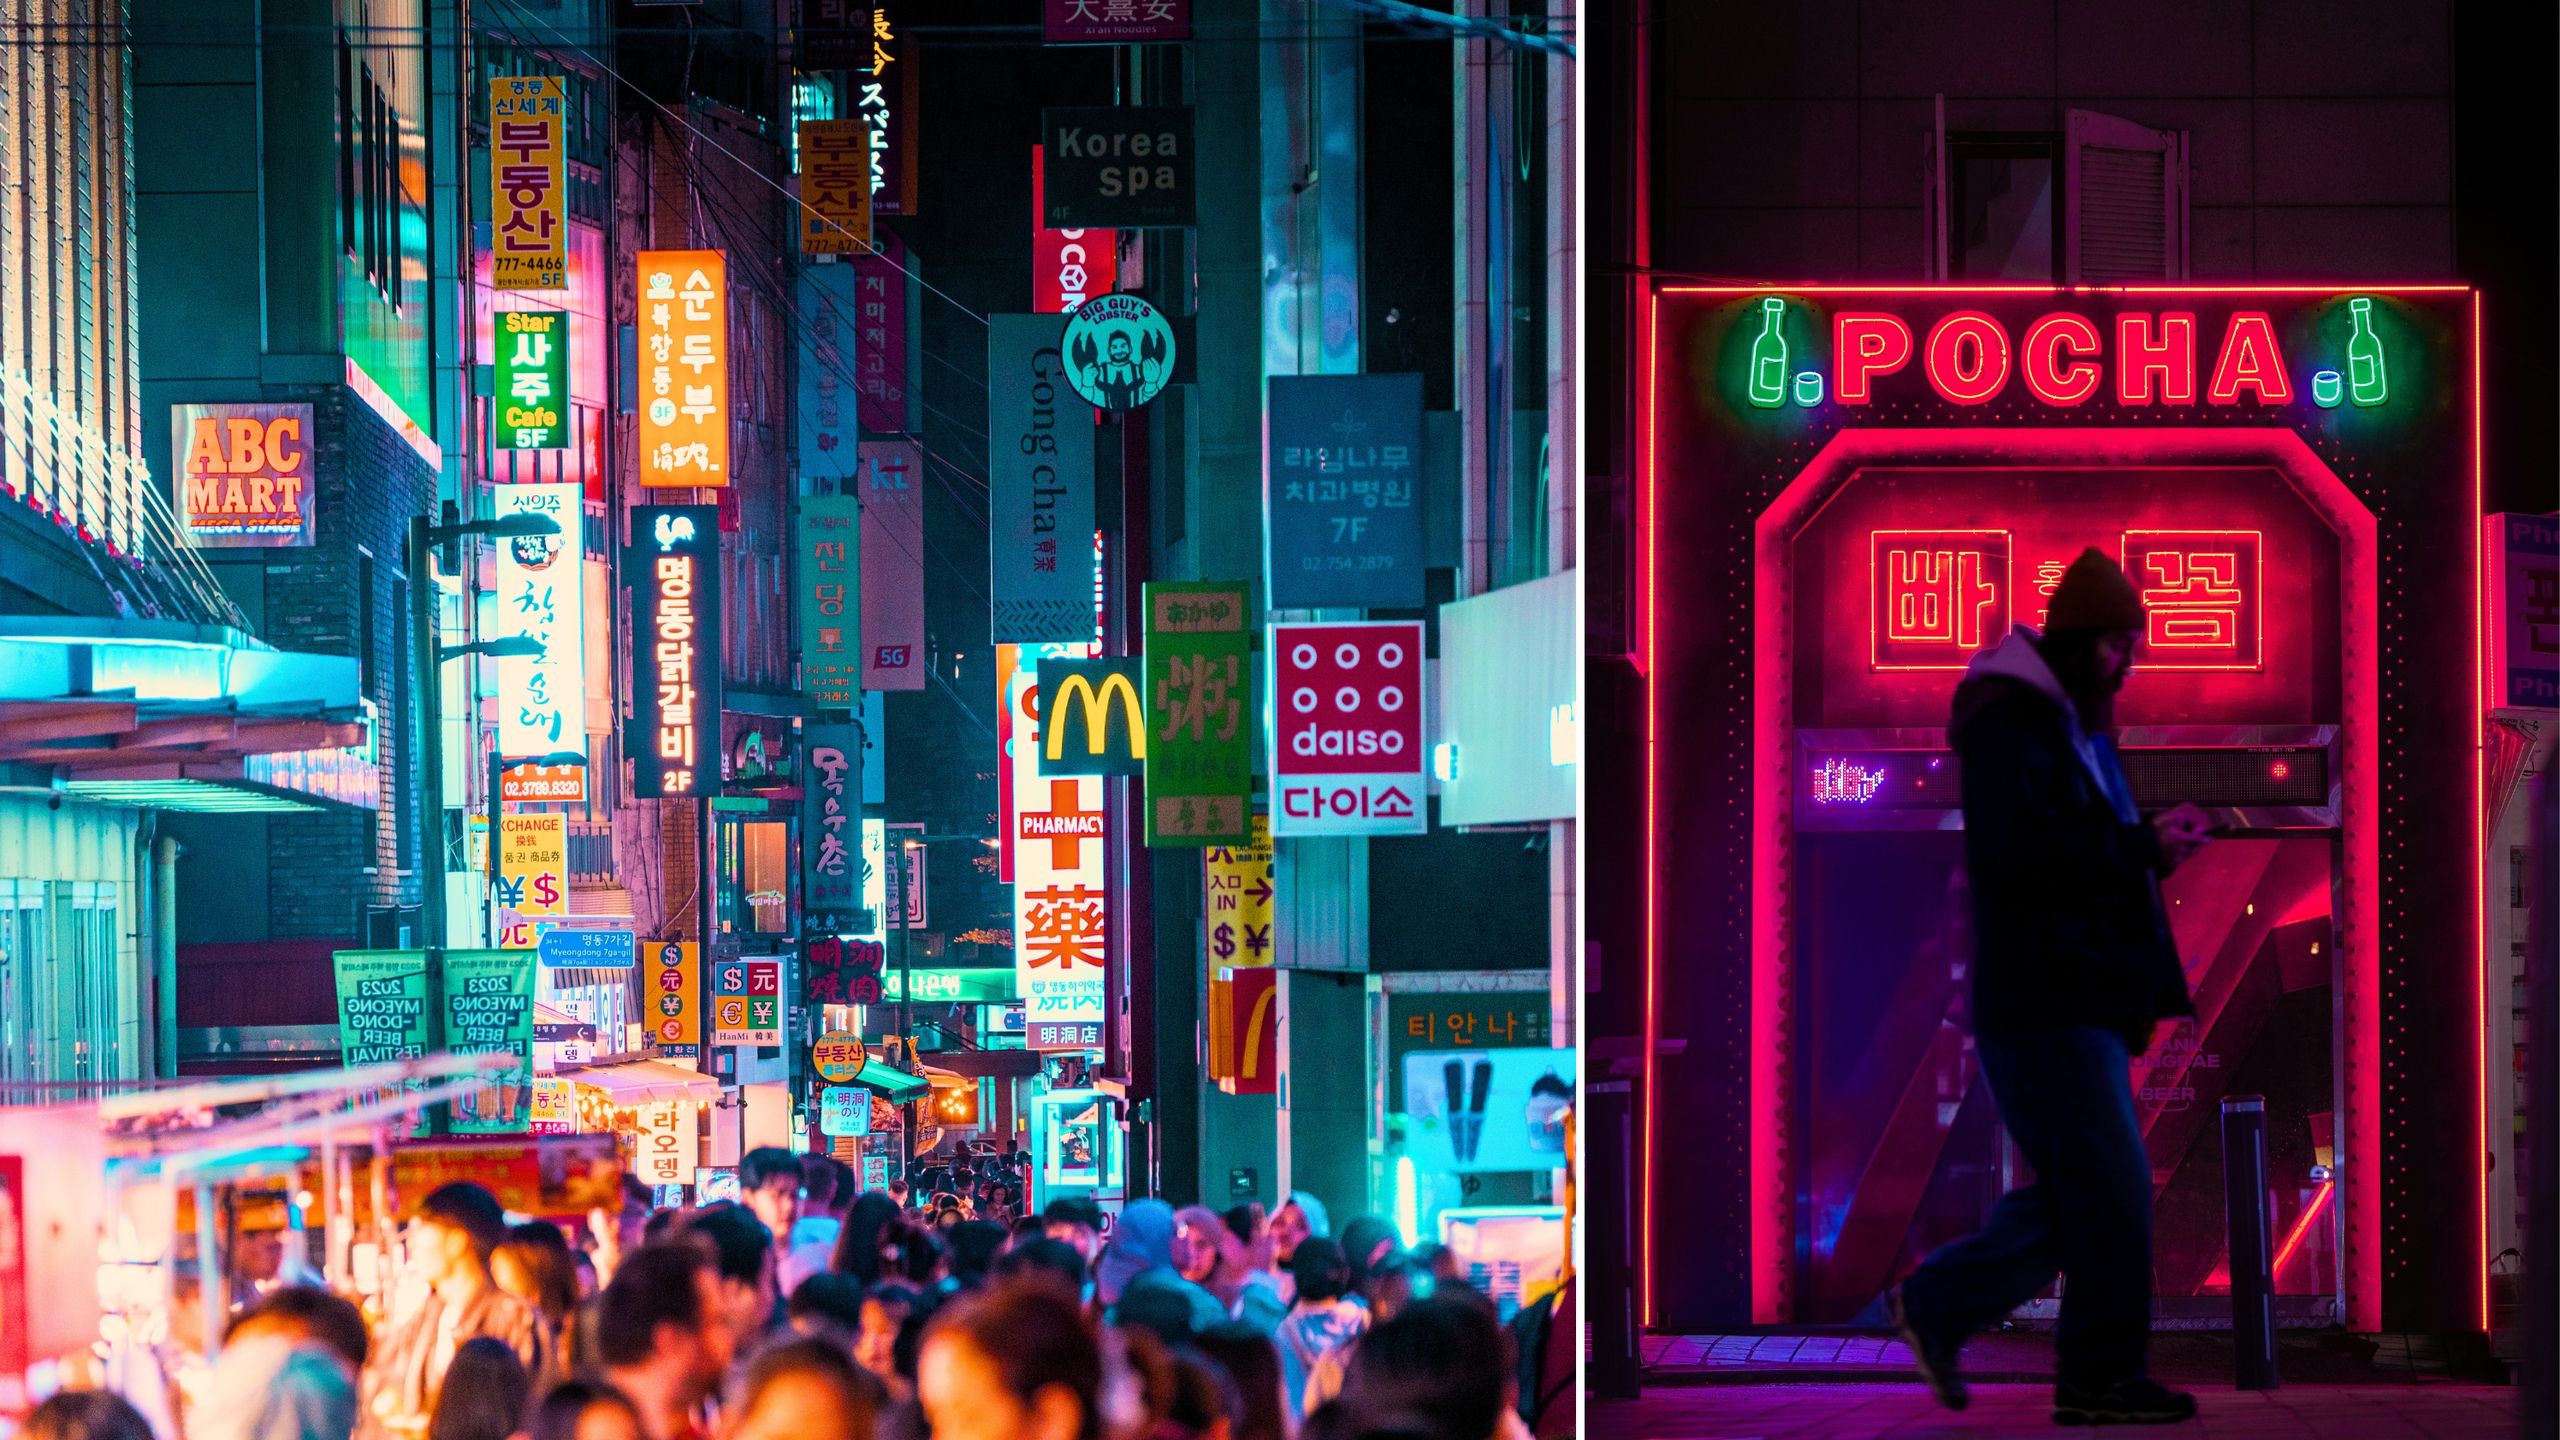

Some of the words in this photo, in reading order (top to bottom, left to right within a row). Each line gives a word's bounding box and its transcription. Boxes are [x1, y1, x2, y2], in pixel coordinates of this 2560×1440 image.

[1114, 26, 1157, 34] Noodles
[510, 80, 543, 95] 명동
[495, 97, 559, 115] 신세계
[1058, 127, 1177, 158] Korea
[500, 121, 557, 251] 부동산
[811, 136, 863, 216] 부동산
[495, 257, 562, 271] 777-4466
[541, 273, 561, 286] 5F
[1080, 301, 1105, 322] BIG
[1108, 298, 1153, 318] GUY'S
[1093, 310, 1139, 324] LOBSTER
[506, 312, 555, 332] Star
[650, 304, 673, 395] 북창동
[679, 269, 717, 425] 순두부
[1833, 311, 2294, 406] POCHA
[510, 334, 552, 406] 사주
[1021, 347, 1061, 456] Gong
[506, 406, 558, 428] Cafe
[654, 406, 672, 419] 3F
[186, 416, 301, 474] ABC
[515, 429, 549, 448] 5F
[1284, 446, 1410, 473] 라임나무
[871, 457, 908, 490] kt
[186, 477, 302, 514] MART
[513, 495, 561, 514] 신의주
[1032, 463, 1067, 536] cha
[1286, 480, 1411, 509] 치과병원
[189, 519, 242, 533] MEGA
[246, 518, 302, 533] STAGE
[1331, 517, 1368, 543] 7F
[1303, 557, 1394, 571] 02.754.2879
[815, 542, 846, 652] 전당포
[1889, 551, 1995, 647] 빠
[2143, 552, 2241, 647] 꼼
[657, 556, 695, 767] 명동닭갈비
[880, 649, 904, 665] 5G
[1157, 654, 1241, 743] 粥
[1292, 722, 1404, 756] daiso
[504, 781, 580, 797] 02.3789.8320
[663, 771, 691, 792] 2F
[1285, 786, 1414, 818] 다이소
[1023, 814, 1104, 834] PHARMACY
[530, 850, 560, 862] 商品券
[534, 873, 559, 908] $
[1210, 875, 1241, 890] 入口
[1217, 895, 1236, 911] IN
[1025, 884, 1105, 970] 藥
[583, 935, 631, 946] 명동7가길
[1213, 923, 1235, 959] $
[1244, 924, 1270, 956] ¥
[551, 948, 602, 957] Myeongdong
[665, 945, 678, 965] $
[663, 972, 680, 989] 元
[723, 967, 744, 992] $
[753, 969, 775, 991] 元
[664, 997, 680, 1015] ¥
[721, 1003, 742, 1025] €
[753, 1002, 773, 1025] ¥
[663, 1021, 680, 1039] €
[719, 1032, 749, 1041] HanMi
[1040, 1026, 1098, 1044] 明洞店
[1408, 1011, 1518, 1044] 티안나
[815, 1044, 862, 1063] 부동산
[2128, 1054, 2220, 1068] ONGDAE
[823, 1064, 858, 1076] 플러스
[837, 1092, 865, 1106] 明洞
[2140, 1087, 2195, 1100] BEER
[841, 1107, 861, 1118] のり
